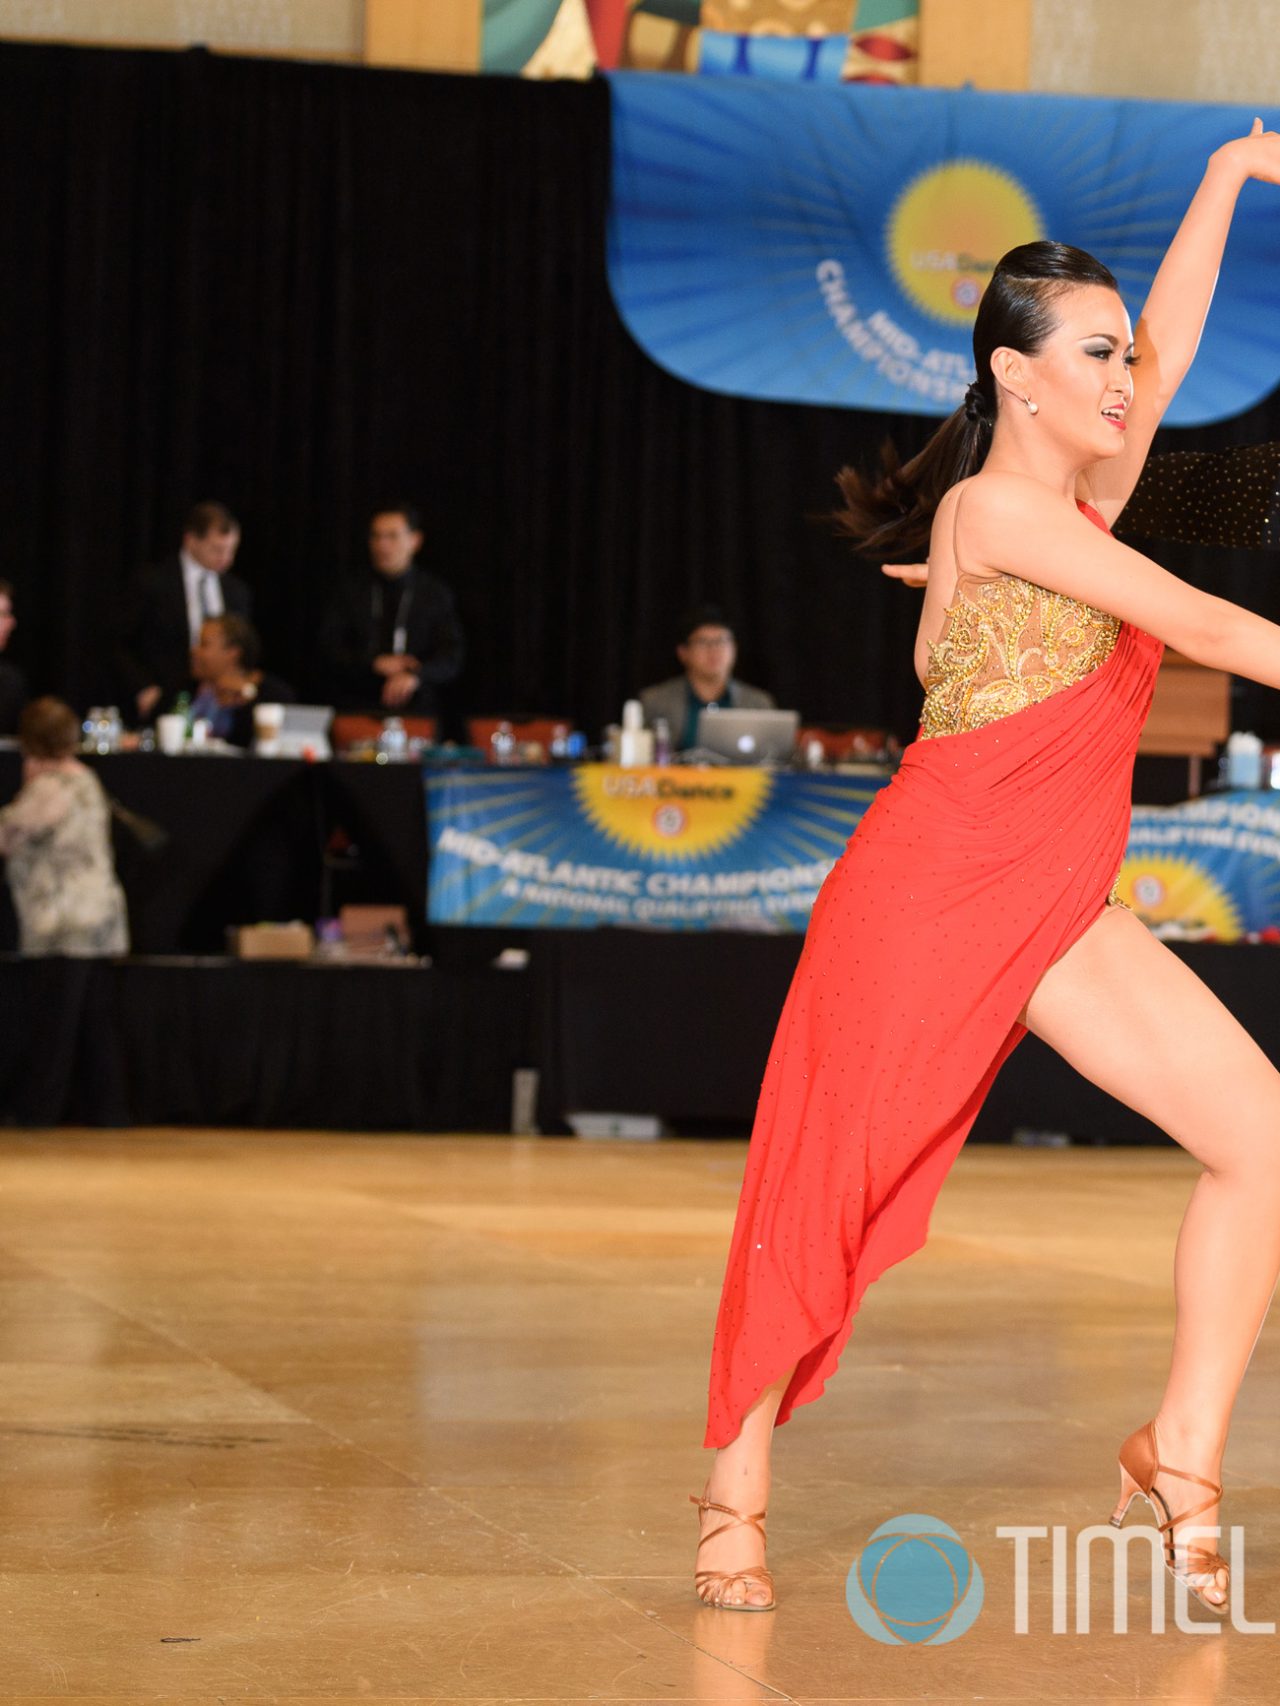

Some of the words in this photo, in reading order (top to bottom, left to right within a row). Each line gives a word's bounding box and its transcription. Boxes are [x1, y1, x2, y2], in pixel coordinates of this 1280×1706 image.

[603, 775, 735, 801] USADance
[436, 826, 642, 897] MID-ATLANTIC
[503, 877, 521, 897] A
[523, 884, 630, 917] NATIONAL
